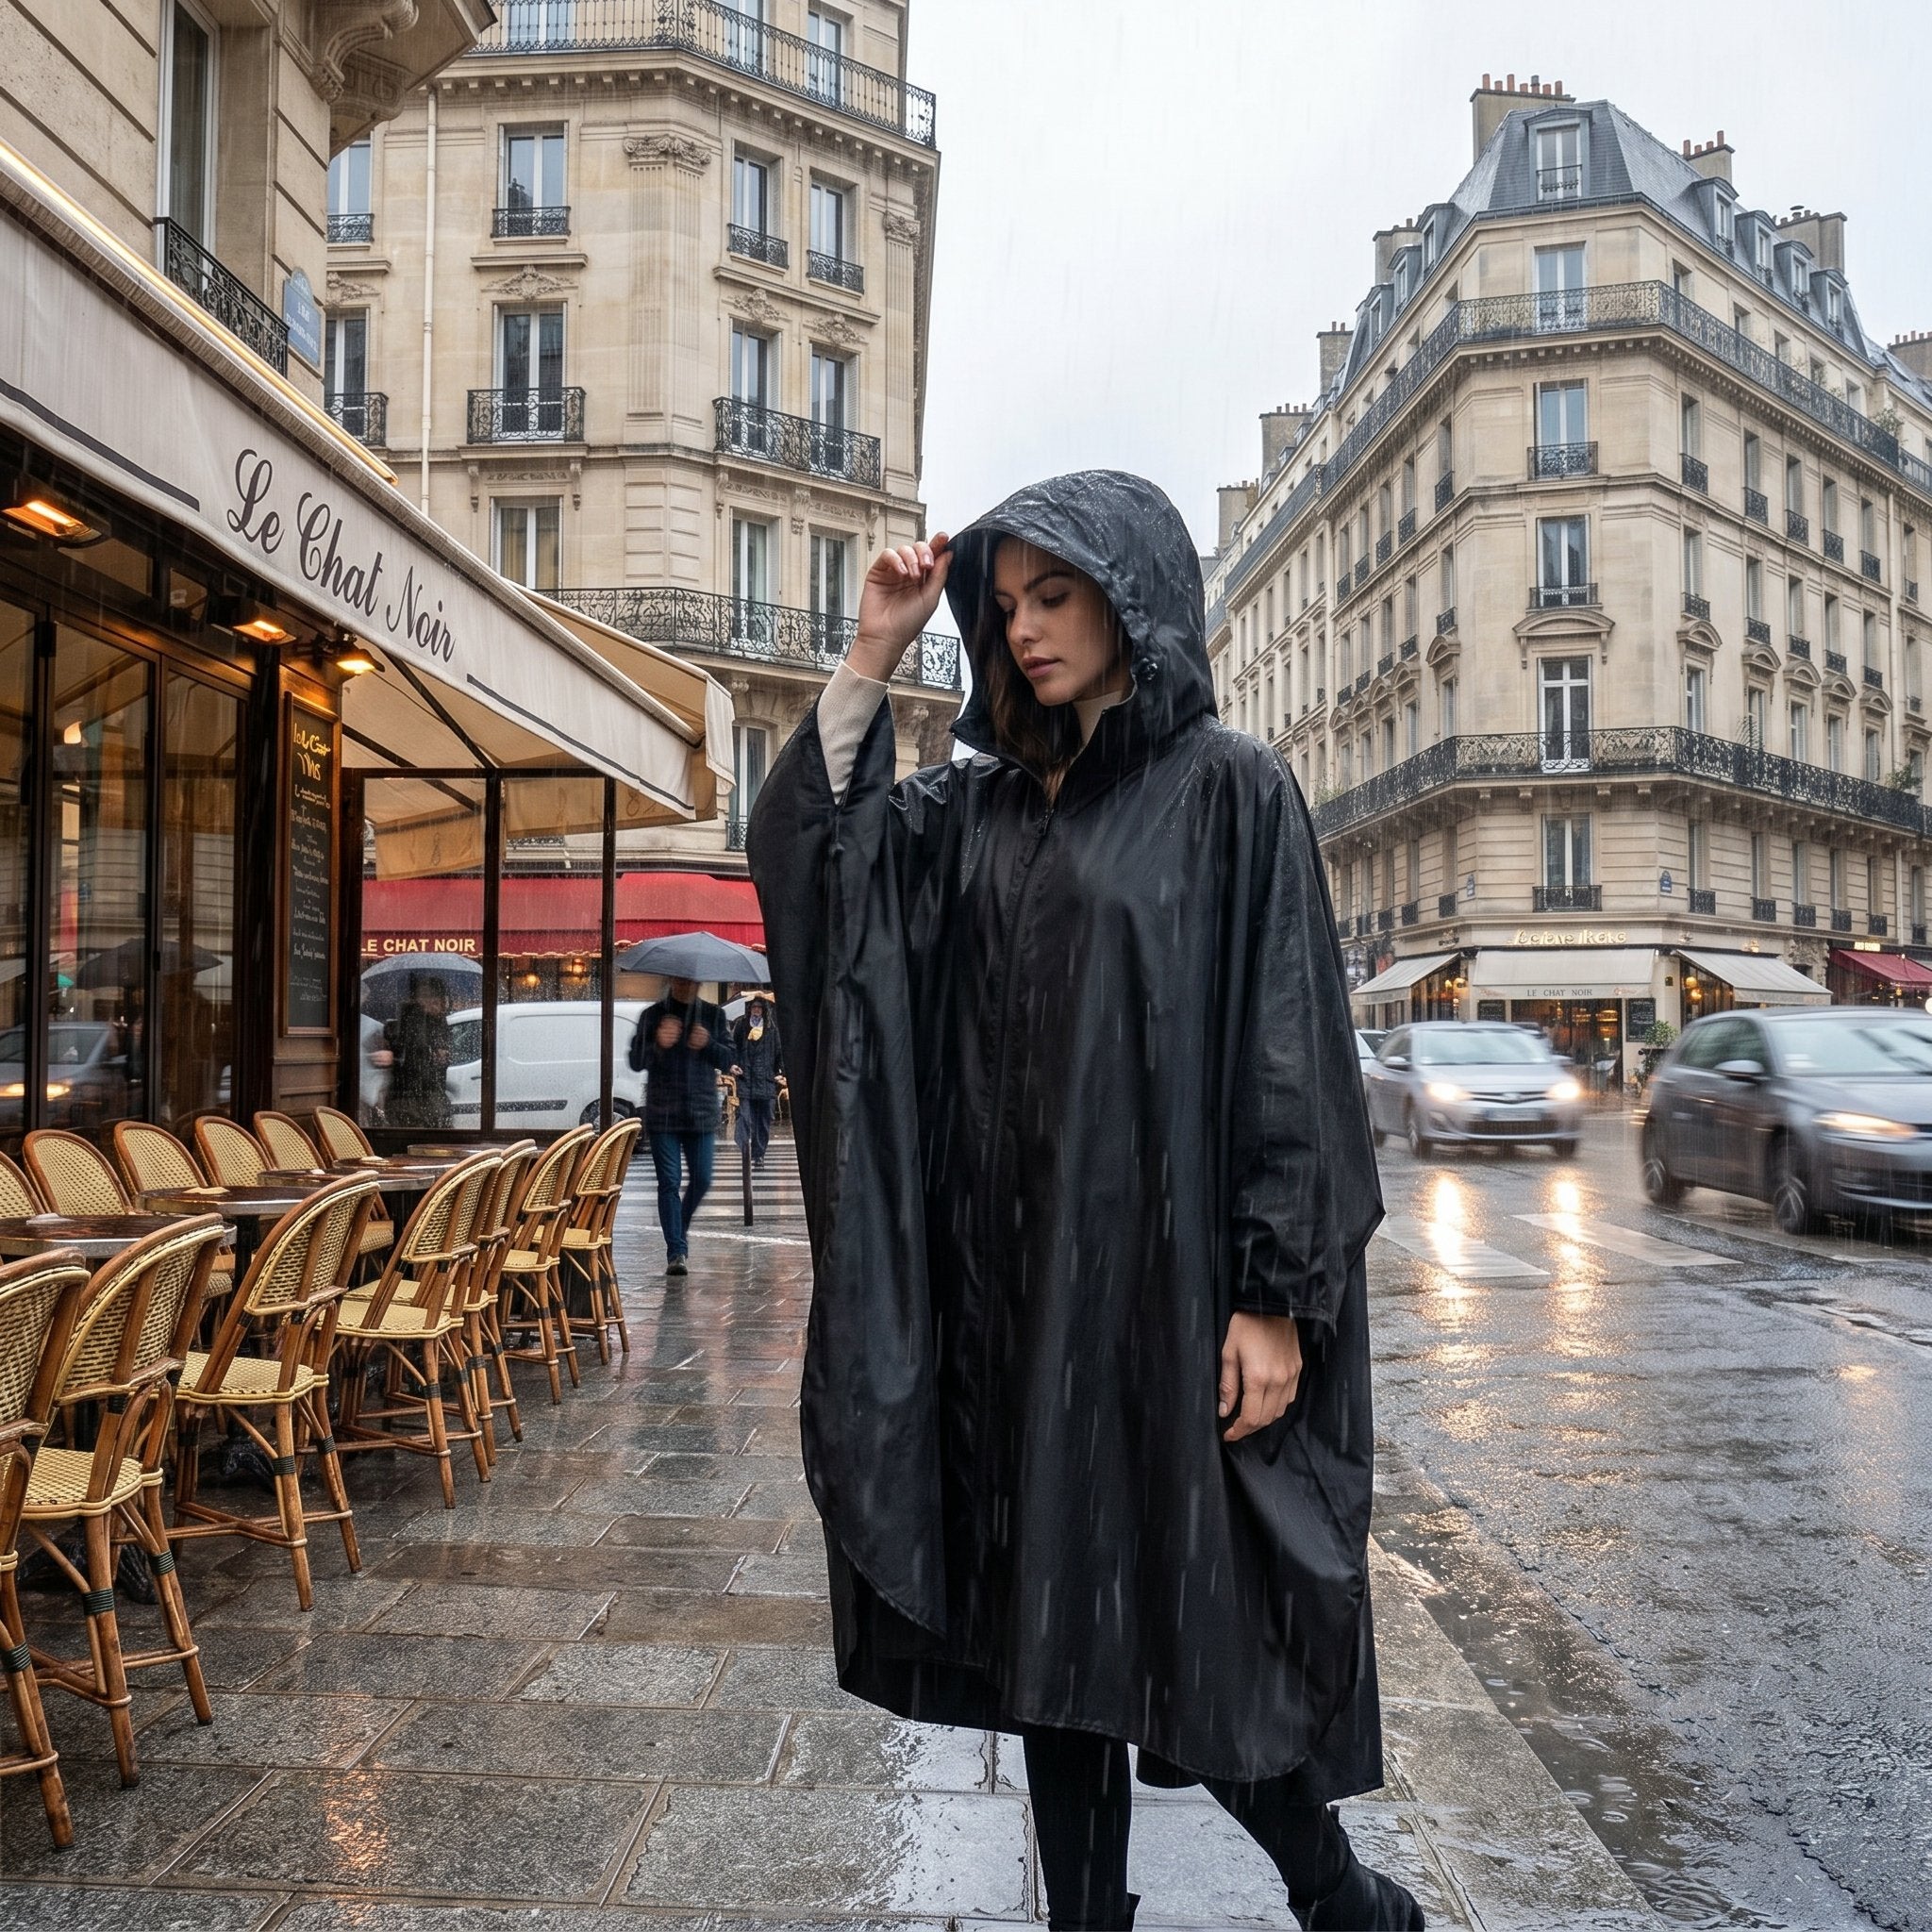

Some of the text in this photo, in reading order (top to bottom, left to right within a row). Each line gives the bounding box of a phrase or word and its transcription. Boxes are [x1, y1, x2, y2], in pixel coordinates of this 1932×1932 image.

[226, 448, 458, 662] Le Chat Noir
[383, 939, 429, 952] CHAT
[434, 939, 475, 952] NOIR
